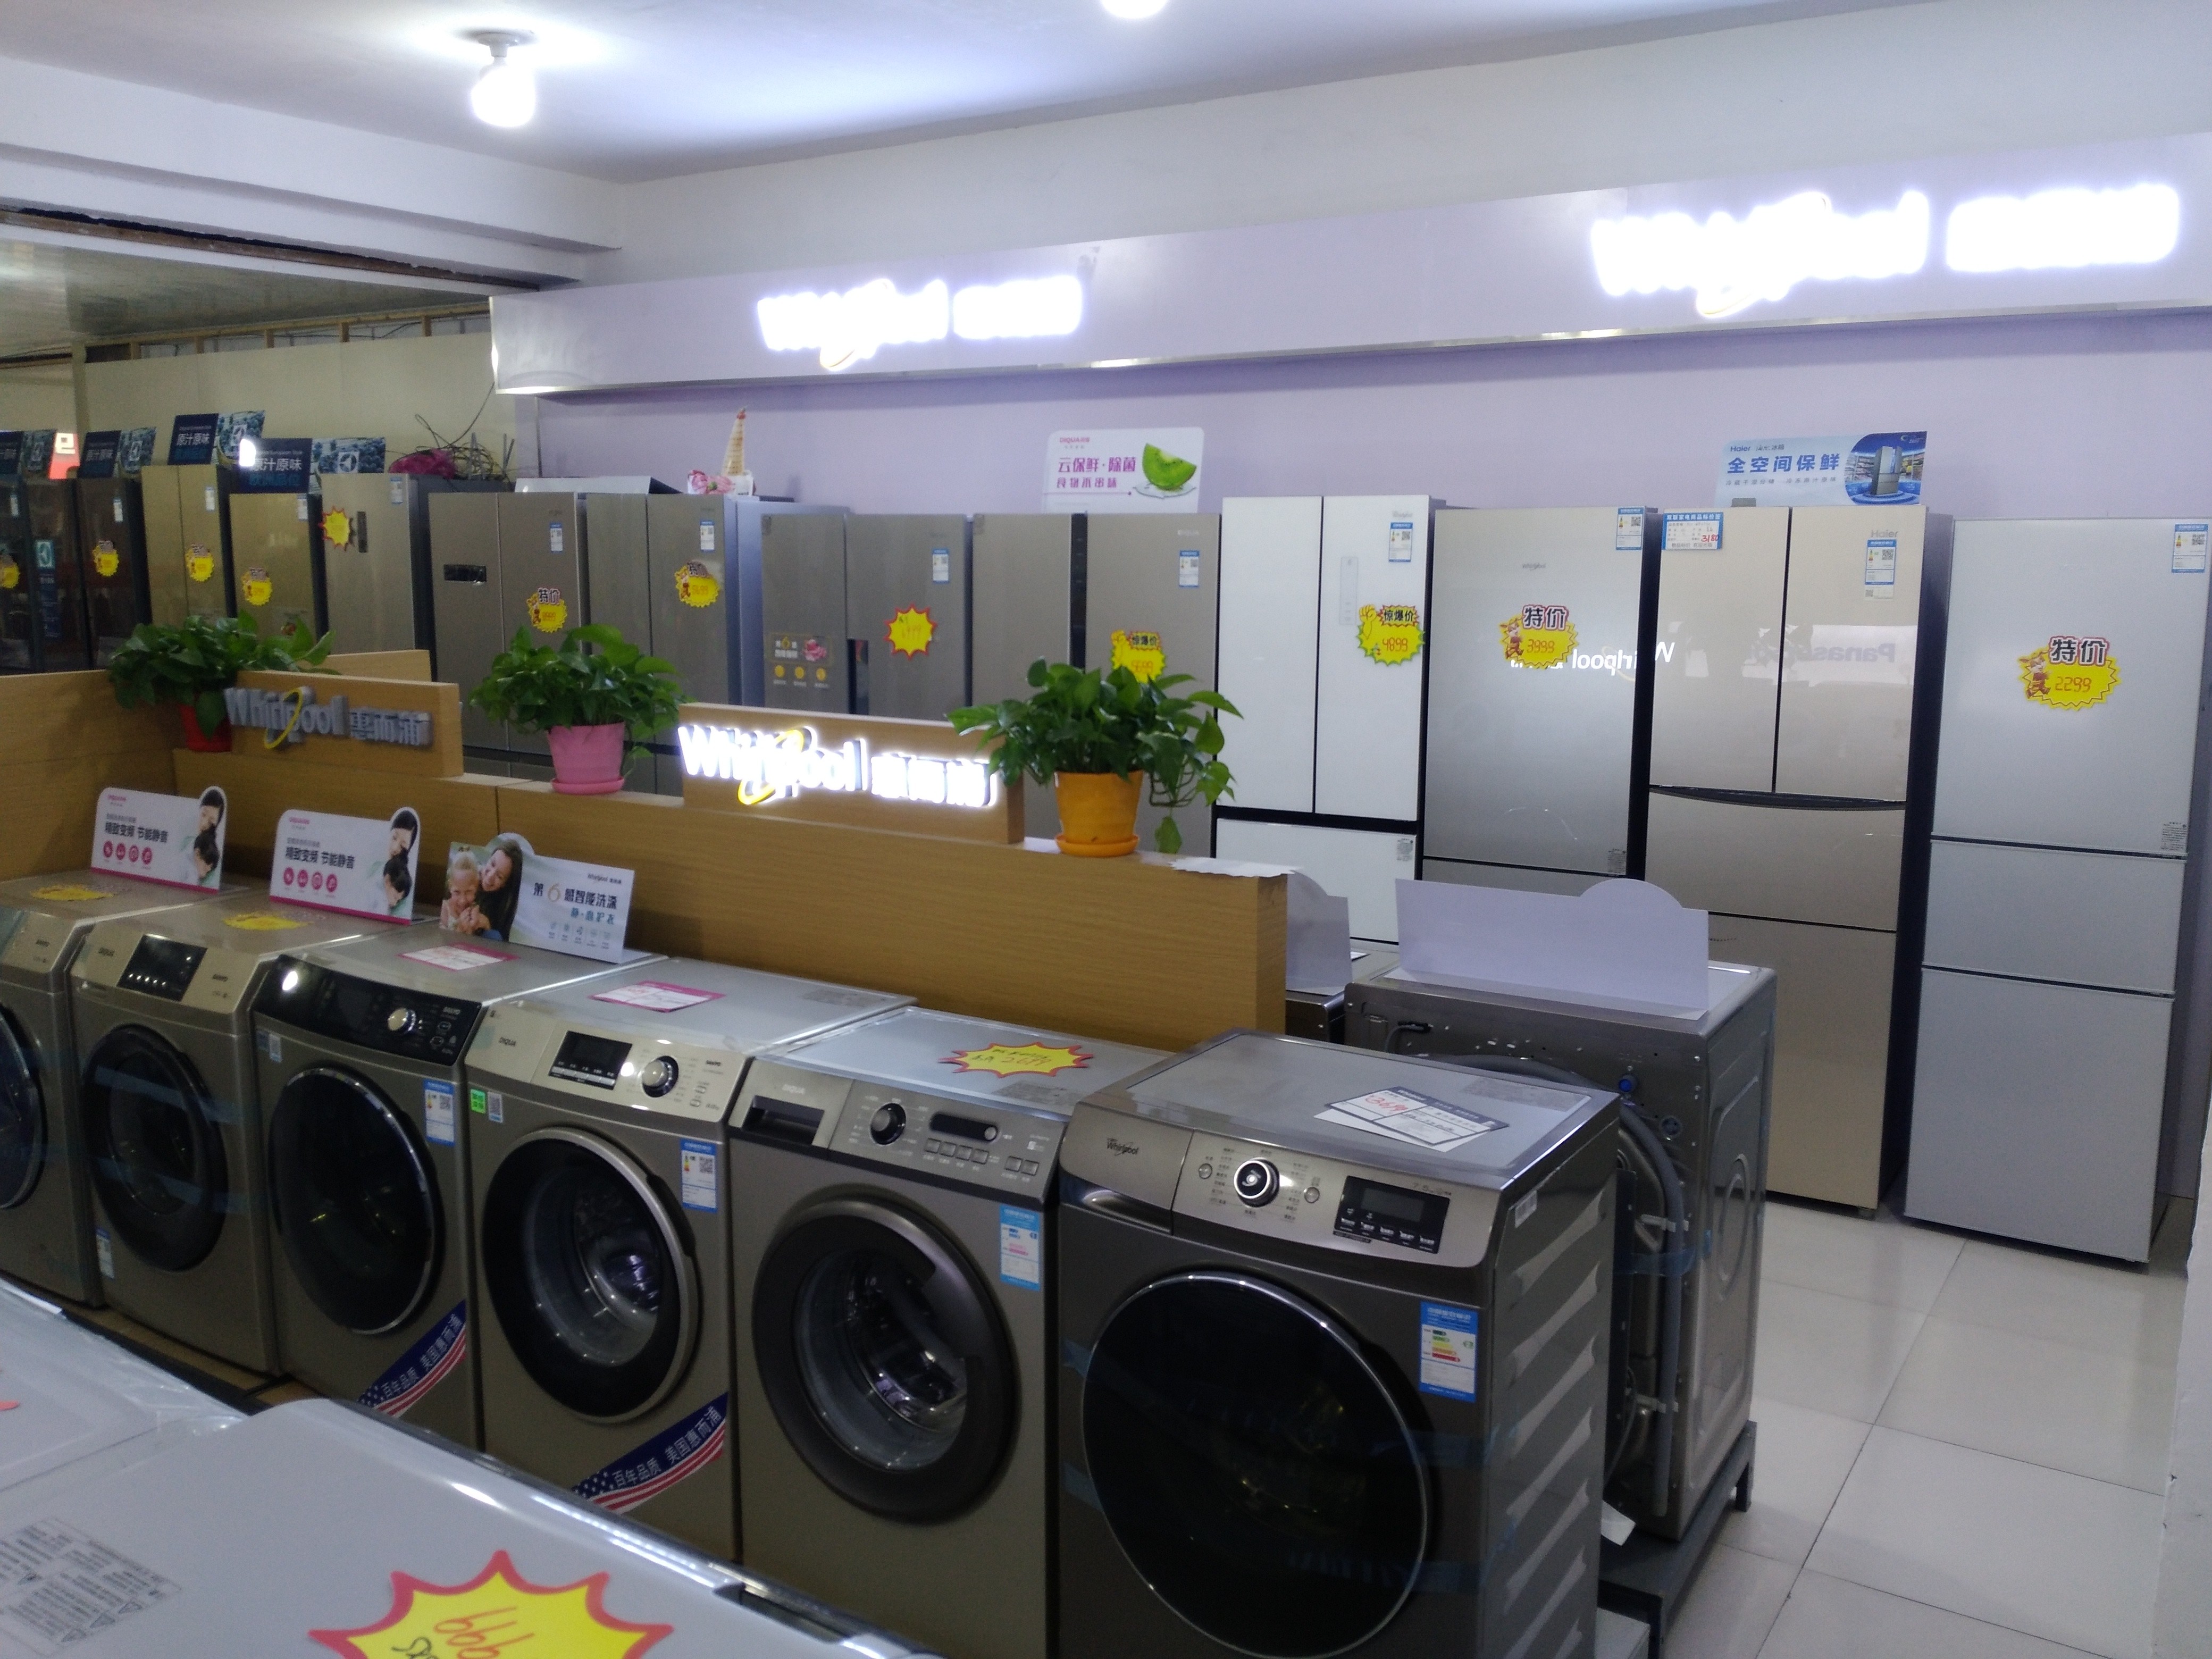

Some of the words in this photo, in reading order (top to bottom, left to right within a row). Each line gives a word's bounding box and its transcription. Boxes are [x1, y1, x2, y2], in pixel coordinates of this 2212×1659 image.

[177, 433, 210, 446] 原汁原味
[252, 458, 302, 471] 原汁原味
[1727, 453, 1840, 474] 全空间保鲜
[1871, 530, 1898, 538] Haier
[538, 588, 560, 604] 特价
[1383, 611, 1414, 622] 惊爆价
[1524, 606, 1566, 630] 特价
[1382, 637, 1409, 652] 4899
[2051, 638, 2106, 664] 特价
[2055, 676, 2092, 693] 2299
[224, 686, 348, 750] Whirlpool
[677, 726, 868, 805] Whirlpool
[612, 1457, 662, 1487] 百年品质
[665, 1406, 722, 1465] 美国惠而浦
